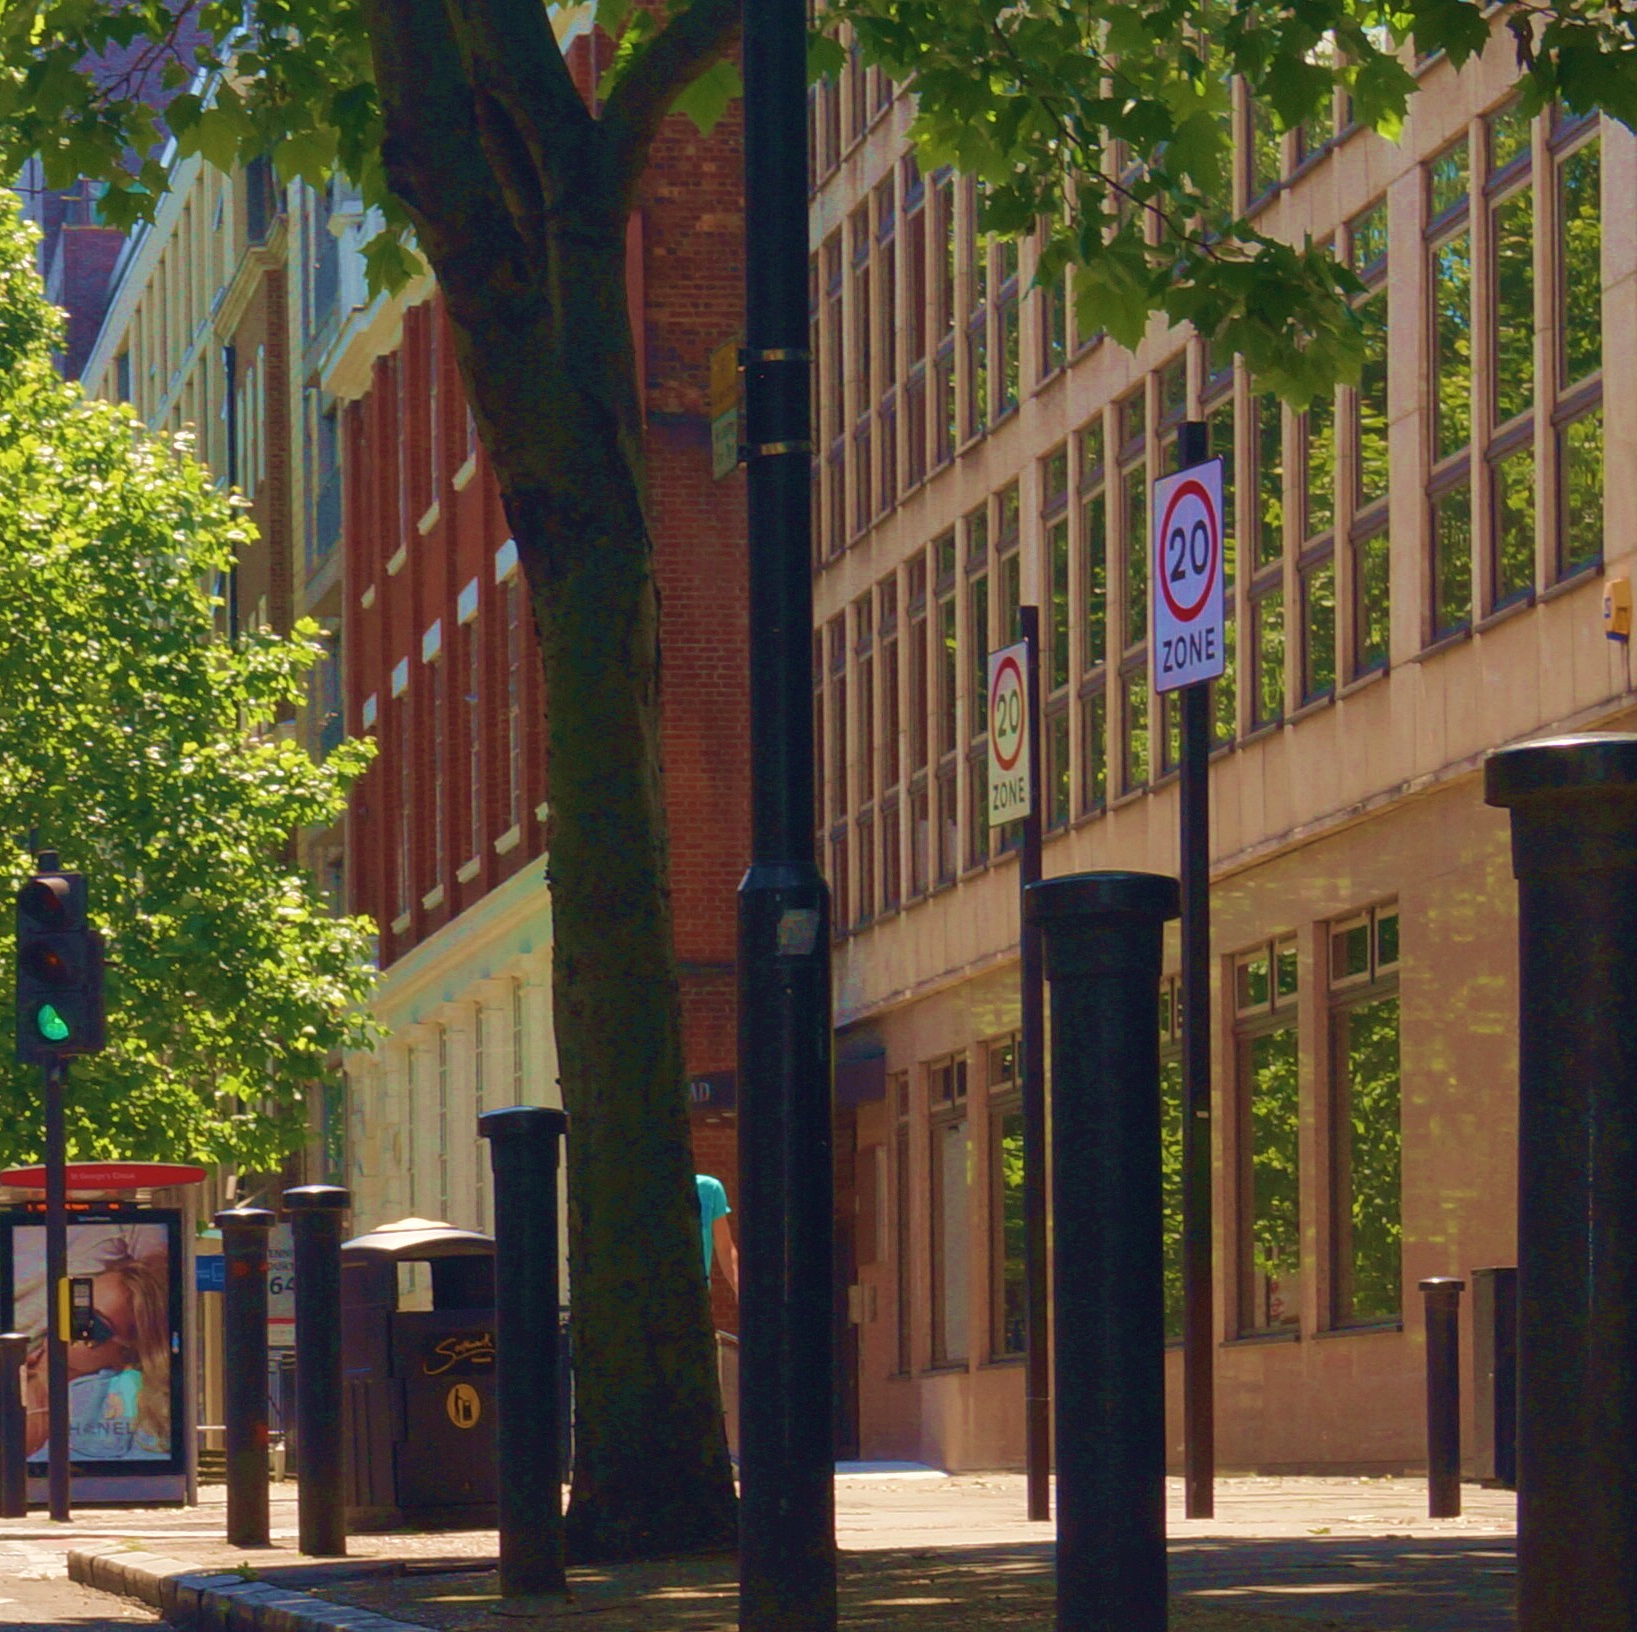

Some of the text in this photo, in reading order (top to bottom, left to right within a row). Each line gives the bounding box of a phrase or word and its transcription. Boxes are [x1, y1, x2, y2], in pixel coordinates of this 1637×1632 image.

[1169, 519, 1210, 583] 20
[1162, 627, 1216, 673] ZONE
[996, 689, 1020, 738] 20
[993, 776, 1025, 811] ZONE
[69, 1421, 135, 1435] HANEL
